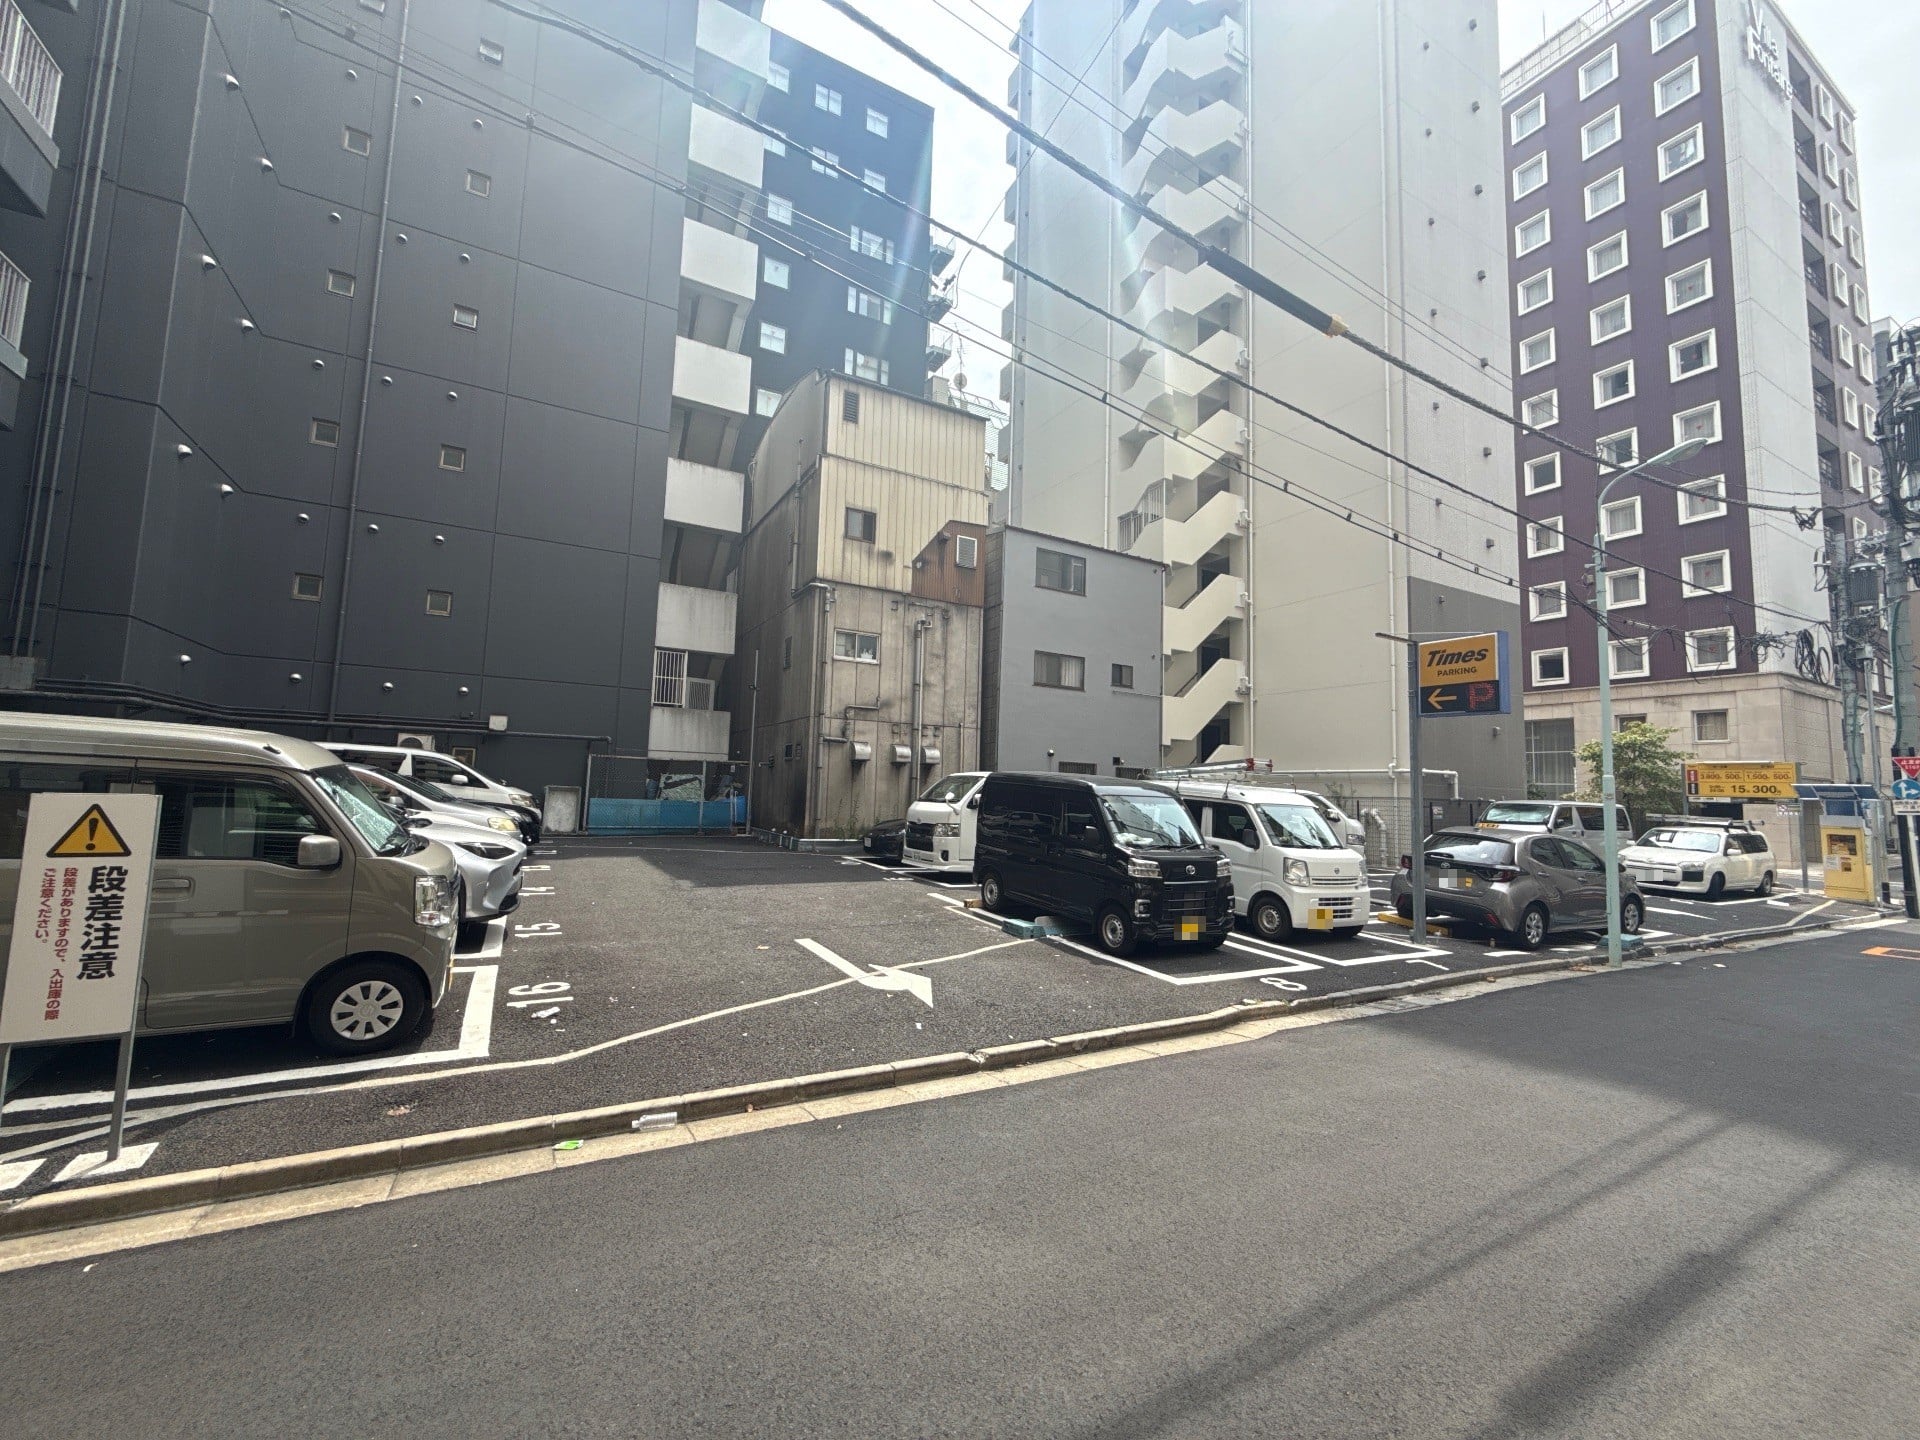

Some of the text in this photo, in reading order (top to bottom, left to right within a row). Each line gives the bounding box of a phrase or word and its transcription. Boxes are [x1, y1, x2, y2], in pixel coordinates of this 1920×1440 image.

[1426, 648, 1489, 667] Times
[1437, 666, 1477, 677] PARKING
[35, 868, 57, 944] ご注意ください。
[76, 865, 129, 981] 段差注意
[514, 922, 563, 938] 15
[1259, 977, 1308, 991] 8
[506, 981, 574, 1008] 16
